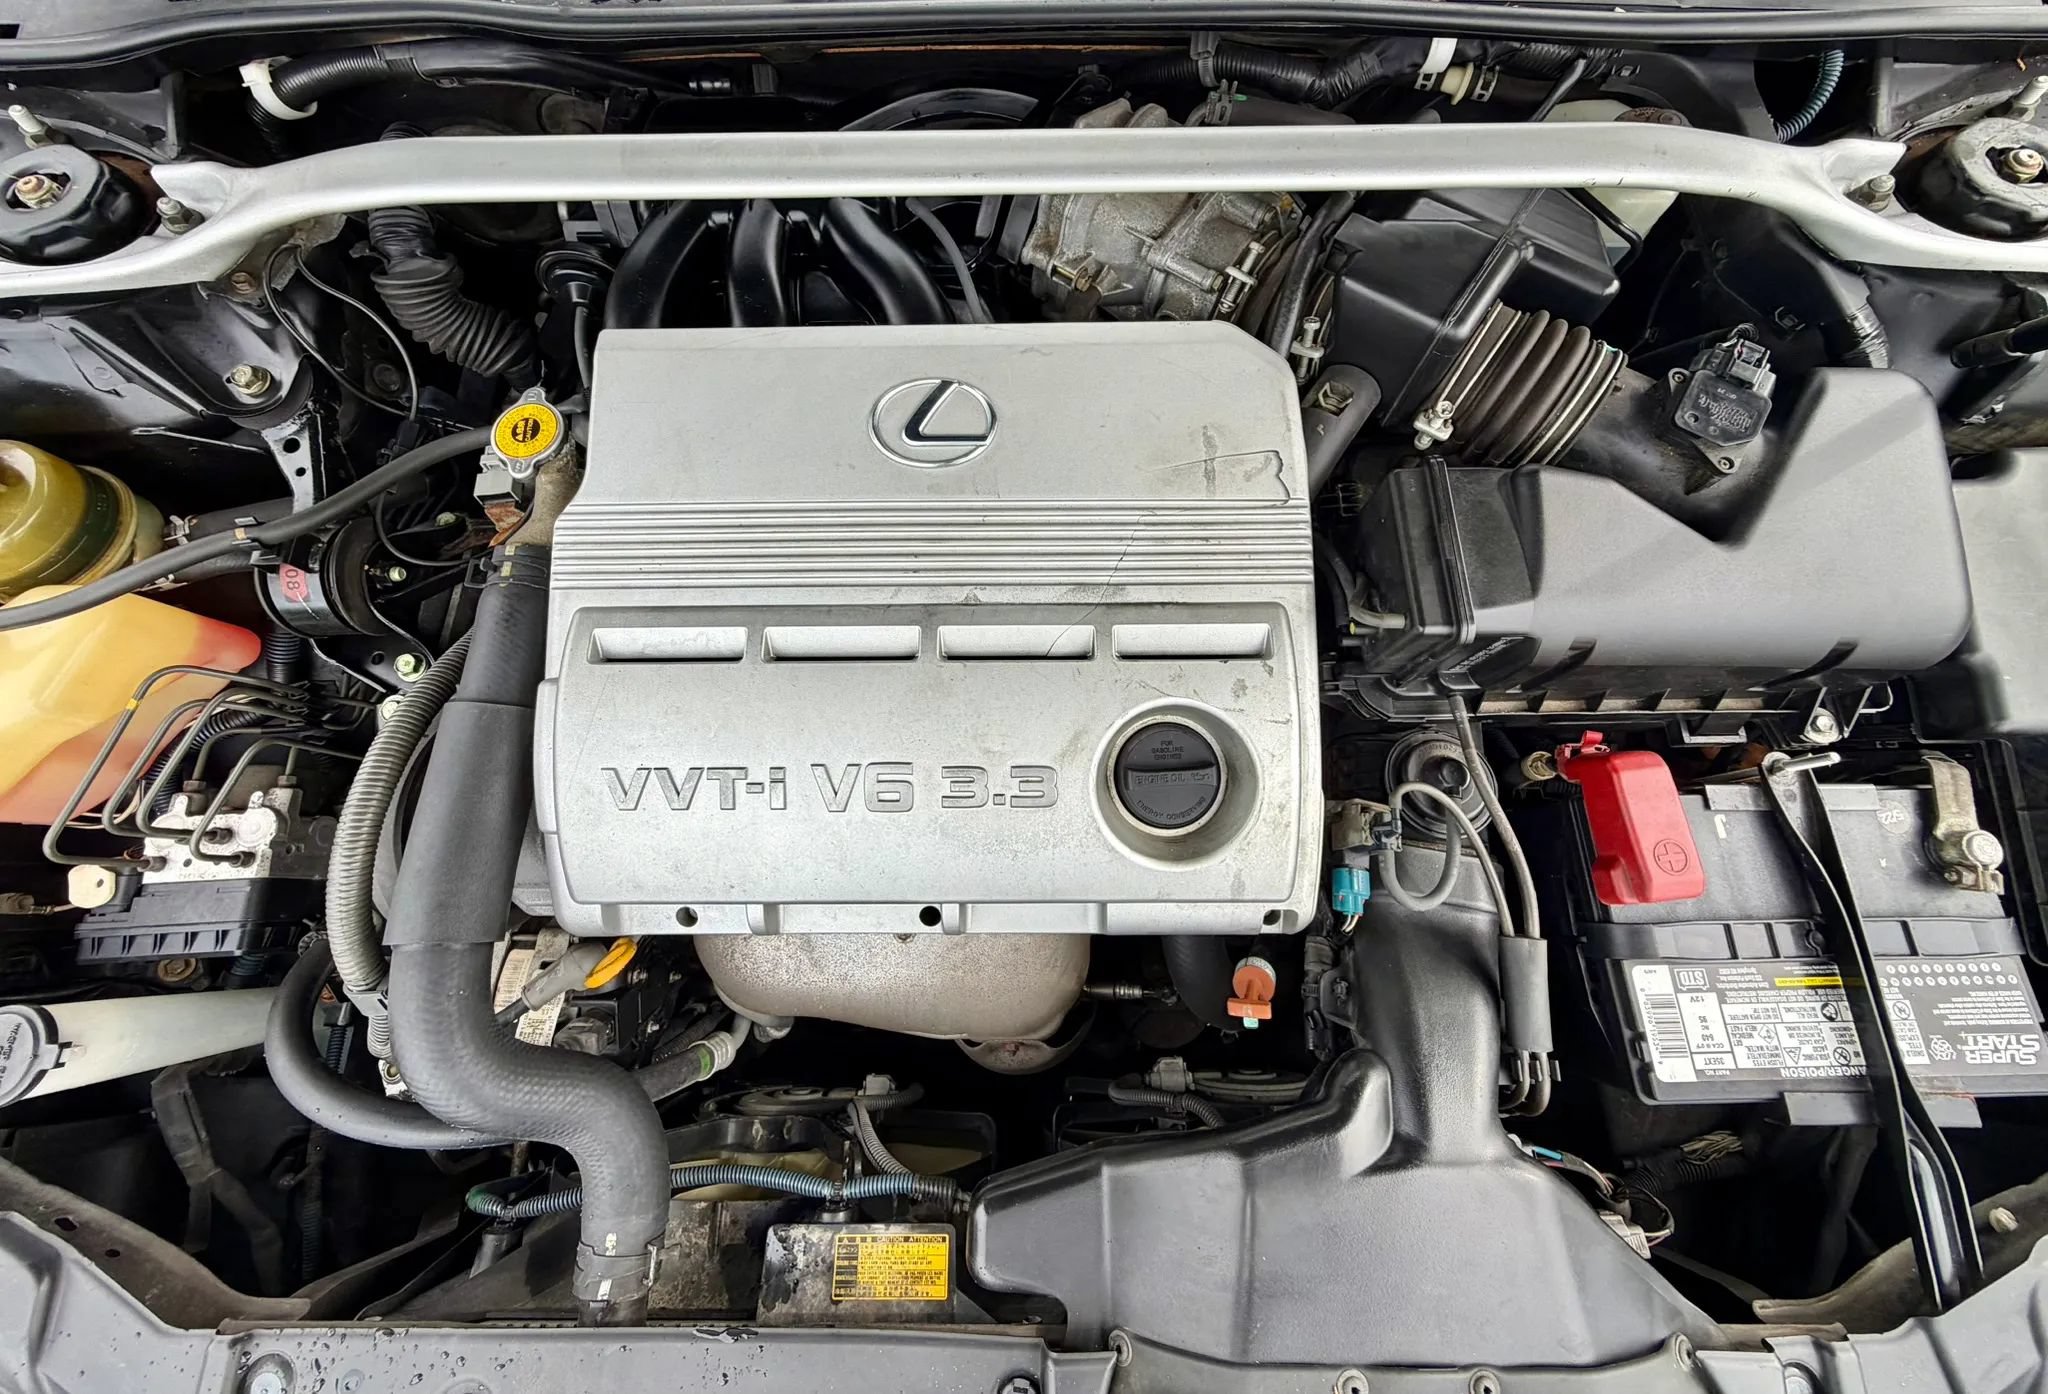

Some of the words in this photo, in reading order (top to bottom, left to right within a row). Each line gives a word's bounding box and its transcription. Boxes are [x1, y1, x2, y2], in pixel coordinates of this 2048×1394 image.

[285, 568, 301, 591] 08
[1151, 746, 1185, 754] GASOLINE
[1135, 773, 1169, 785] ENGINE
[1170, 773, 1186, 783] OIL
[601, 766, 788, 811] VVT-i
[810, 761, 914, 813] V6
[941, 765, 1059, 809] 3.3
[1679, 970, 1704, 985] STD
[1689, 995, 1705, 1003] 12V
[1698, 1015, 1708, 1023] 95
[1962, 1034, 2040, 1051] START
[1703, 1057, 1726, 1066] 35EXT
[1965, 1050, 2038, 1065] SUPER
[1780, 1065, 1867, 1078] ANGER/POISON
[908, 1235, 943, 1243] ATTENTION
